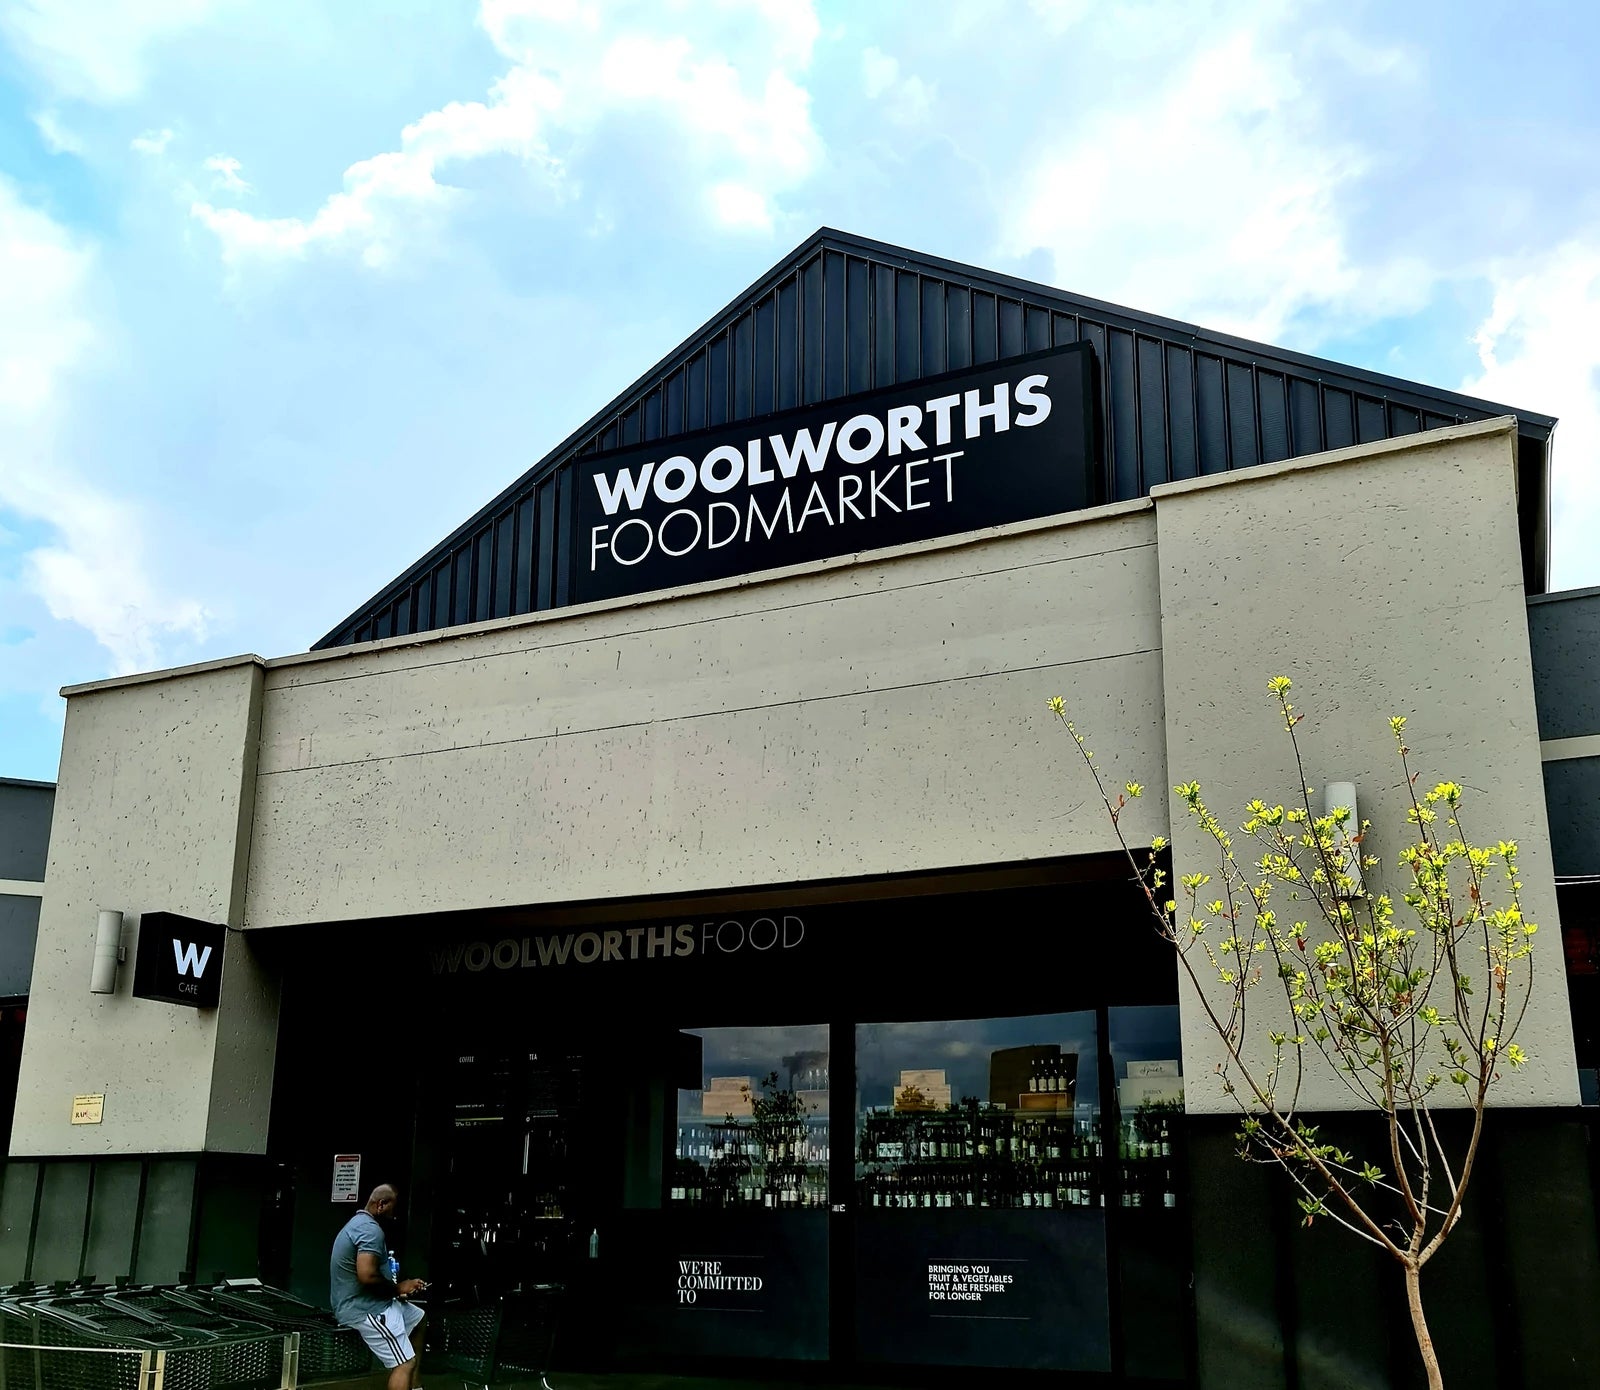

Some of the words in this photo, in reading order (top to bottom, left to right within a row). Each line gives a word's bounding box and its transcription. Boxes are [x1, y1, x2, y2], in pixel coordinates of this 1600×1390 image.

[593, 374, 1052, 516] WOOLWORTHS
[590, 450, 965, 572] FOODMARKET
[172, 938, 213, 979] W
[678, 1260, 722, 1275] WE'RE
[928, 1264, 970, 1274] BRINGING
[971, 1265, 990, 1274] YOU
[678, 1274, 763, 1291] COMMITTED
[928, 1273, 951, 1283] FRUIT
[952, 1274, 960, 1283] &
[961, 1274, 1014, 1284] VEGETABLES
[928, 1282, 951, 1292] THAT
[951, 1283, 968, 1292] ARE
[969, 1283, 1006, 1293] FRESHER
[677, 1289, 697, 1304] TO
[928, 1291, 946, 1301] FOR
[947, 1292, 982, 1301] LONGER
